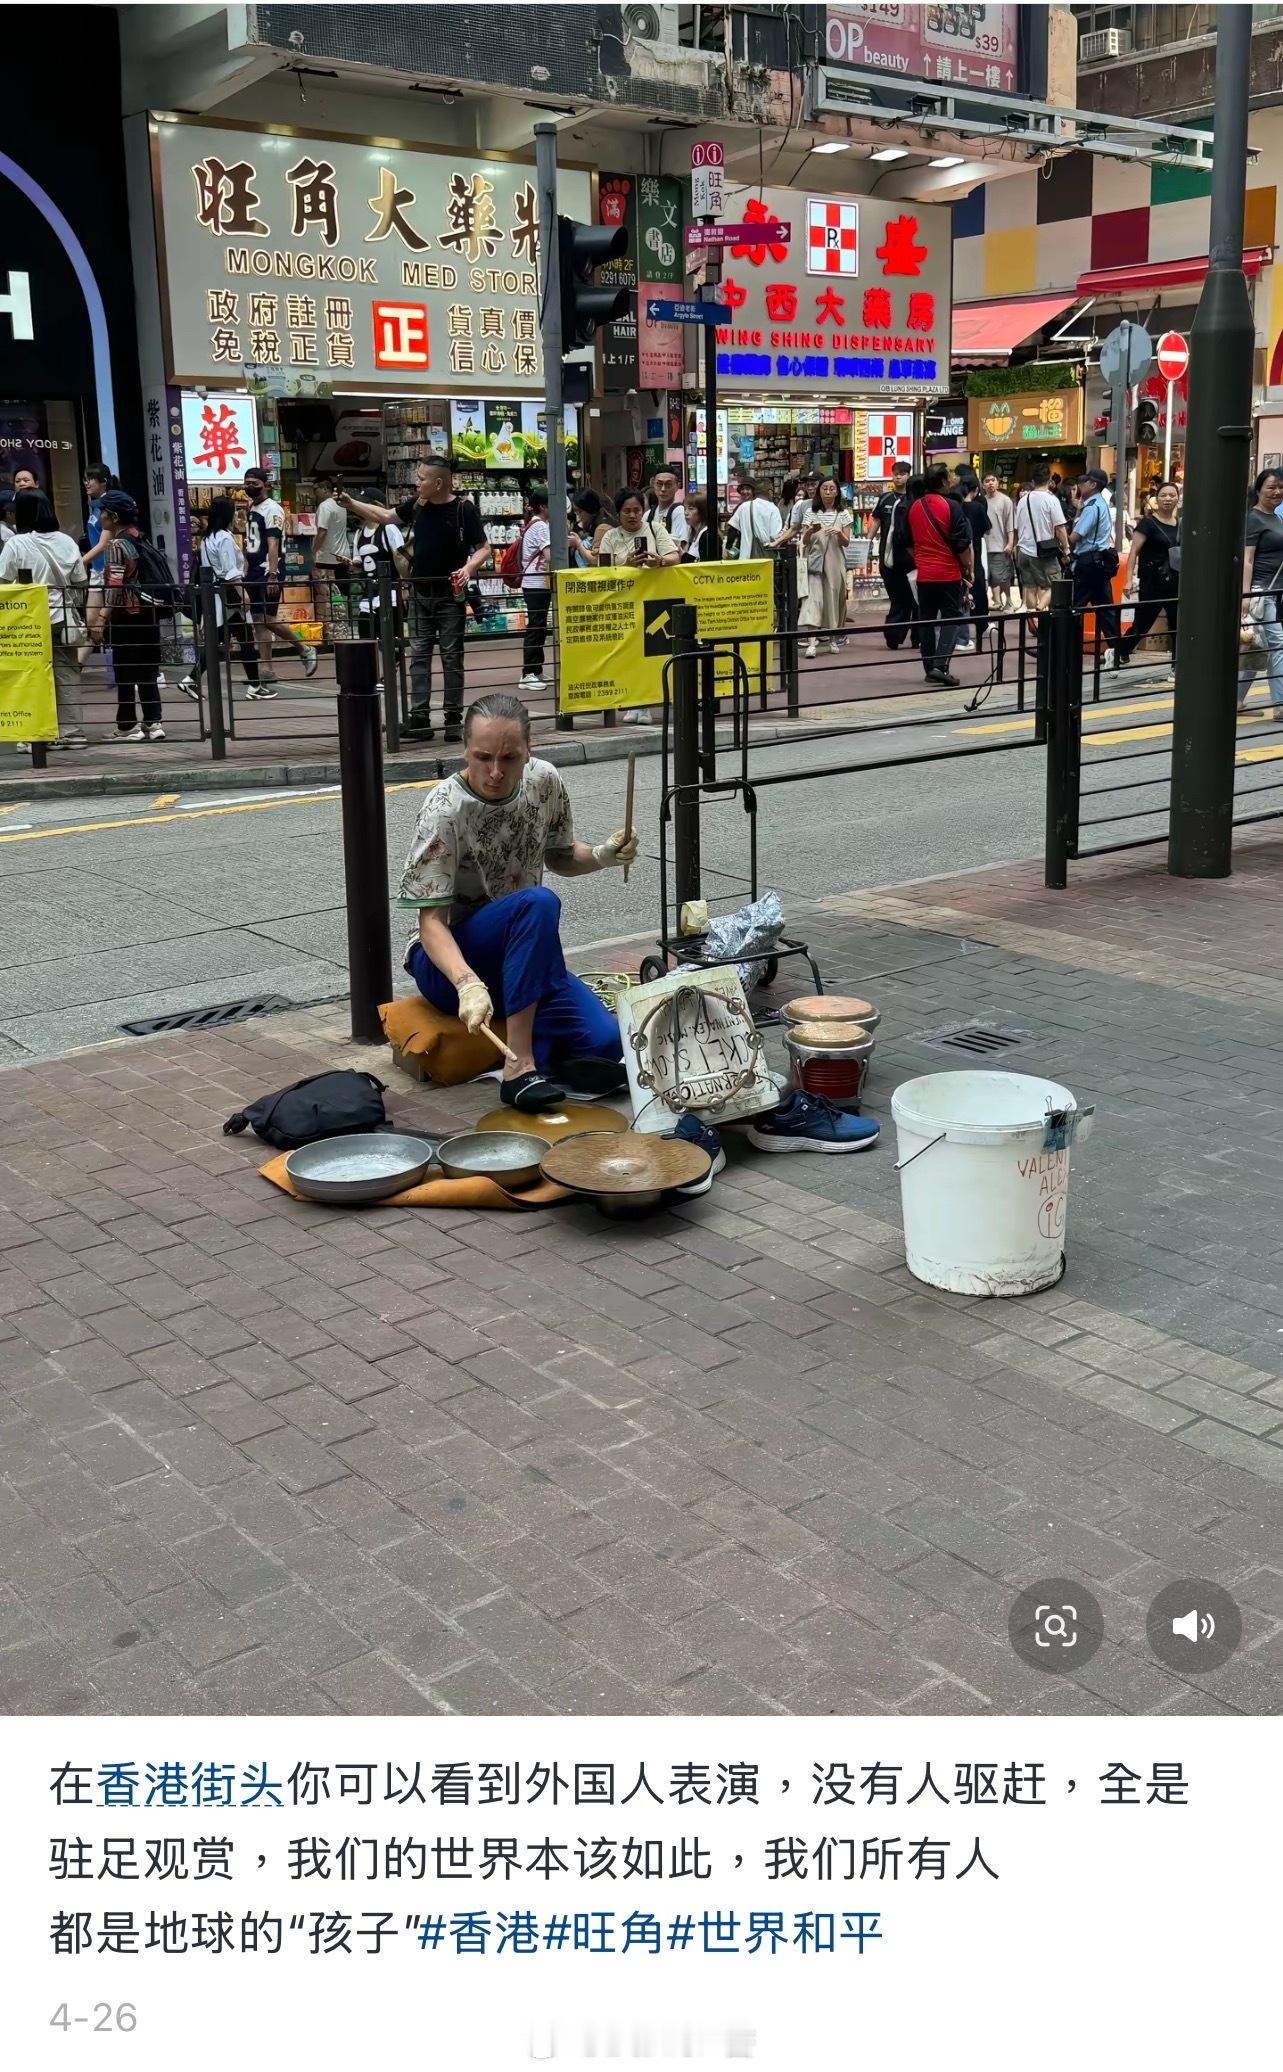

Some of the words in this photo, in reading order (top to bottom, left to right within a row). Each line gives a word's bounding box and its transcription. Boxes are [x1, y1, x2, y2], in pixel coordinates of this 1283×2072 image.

[826, 18, 864, 61] OP
[864, 46, 910, 72] beauty
[975, 34, 999, 52] $39
[936, 56, 1001, 89] 請上一樓
[709, 171, 723, 211] 旺角
[641, 177, 678, 263] 樂文書店
[226, 247, 378, 283] MONGKOK
[402, 261, 458, 290] MED
[470, 267, 542, 297] STOR
[207, 288, 354, 330] 政府註冊
[447, 304, 542, 341] 貨真價
[674, 312, 689, 320] Argyle
[689, 312, 704, 320] Street
[721, 277, 936, 333] 中西大藥房
[211, 327, 355, 368] 免稅正貨
[378, 306, 427, 363] 正
[613, 325, 637, 337] HAIR
[716, 329, 762, 347] WING
[771, 330, 825, 349] SHING
[832, 334, 936, 354] DISPENSARY
[449, 339, 544, 375] 信心保
[147, 399, 165, 496] 紫花油
[192, 403, 248, 475] 藥
[171, 441, 185, 481] 紫花油
[565, 579, 635, 594] 閉路電視運作中
[693, 575, 715, 585] CCTV
[717, 575, 724, 584] in
[726, 573, 761, 584] operation
[7, 624, 33, 632] provided
[12, 710, 32, 718] Office
